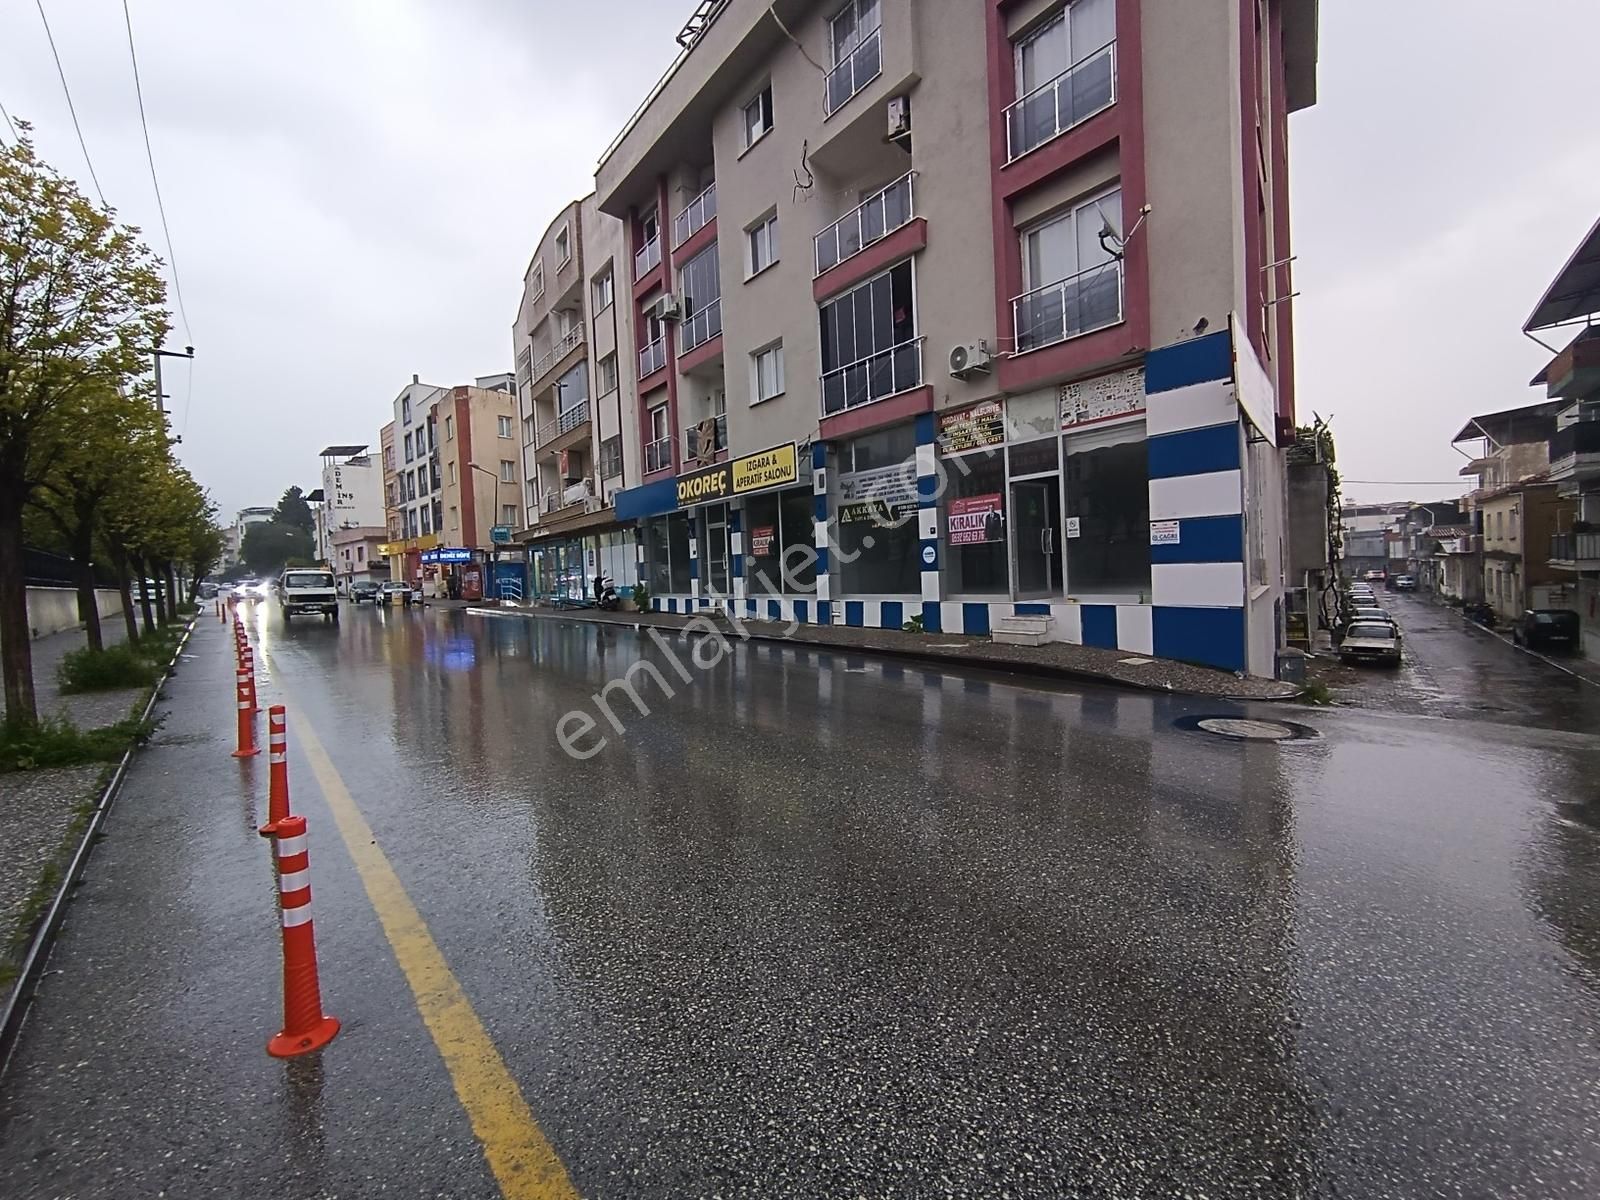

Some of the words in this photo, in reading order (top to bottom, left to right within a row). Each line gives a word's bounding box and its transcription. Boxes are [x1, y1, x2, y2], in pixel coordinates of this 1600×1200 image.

[763, 464, 792, 482] SALONU
[676, 470, 727, 500] OKOREÇ
[851, 504, 884, 516] AKKAYA
